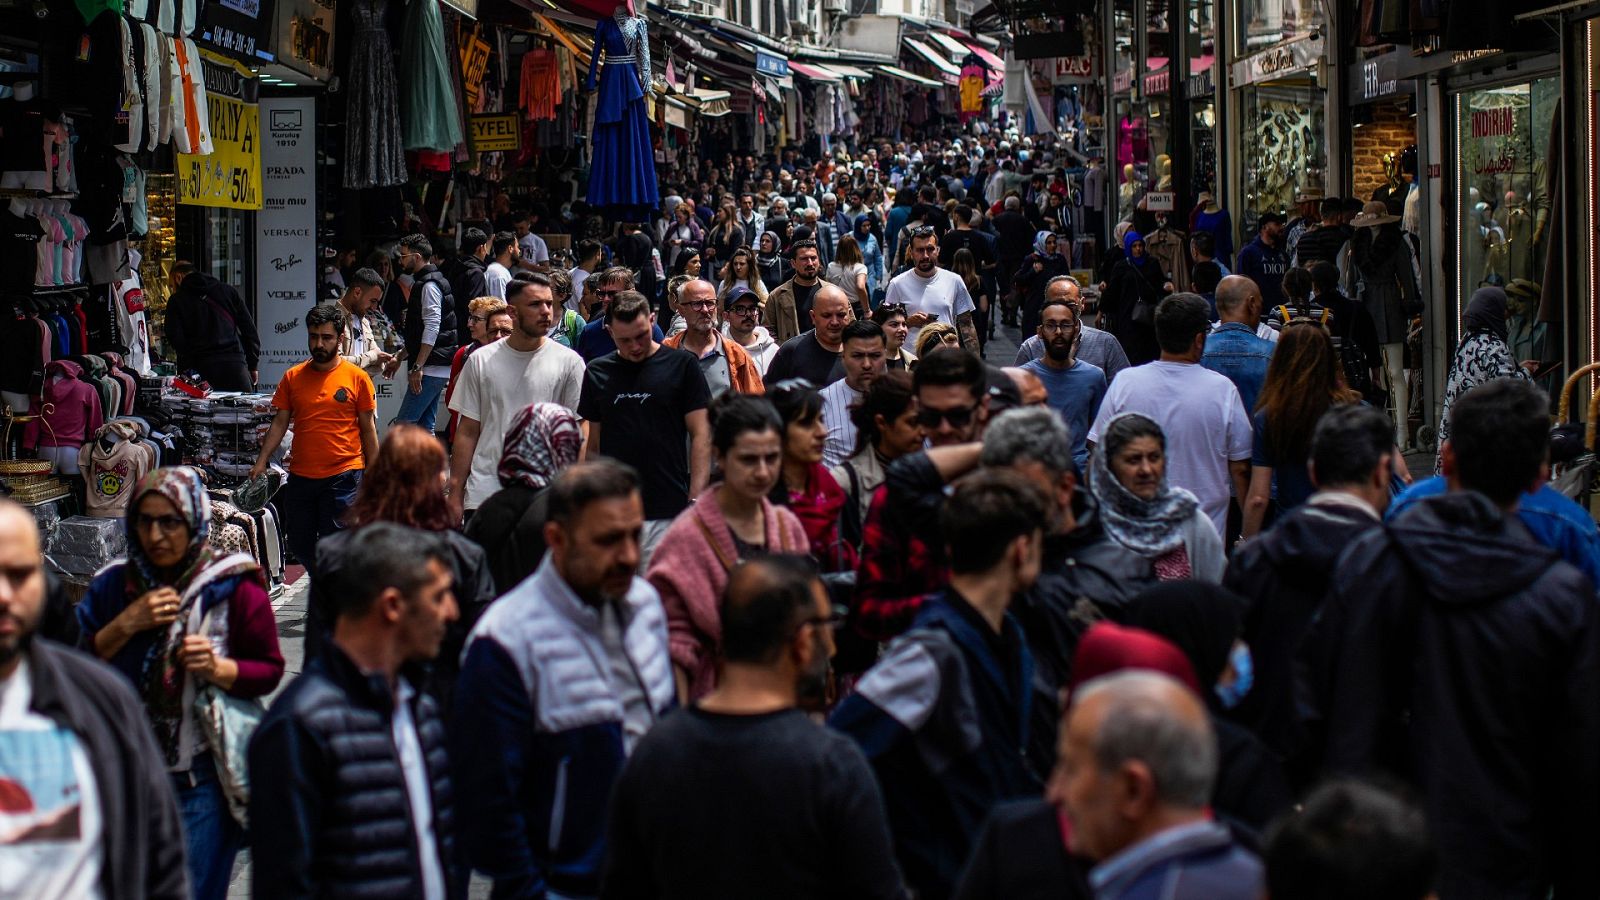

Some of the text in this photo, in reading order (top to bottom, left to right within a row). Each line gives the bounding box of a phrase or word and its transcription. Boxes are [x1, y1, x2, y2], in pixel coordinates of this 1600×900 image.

[1148, 195, 1162, 203] 500
[270, 254, 302, 271] Ray-Ban
[267, 290, 306, 299] VOGUE
[613, 392, 652, 404] pray
